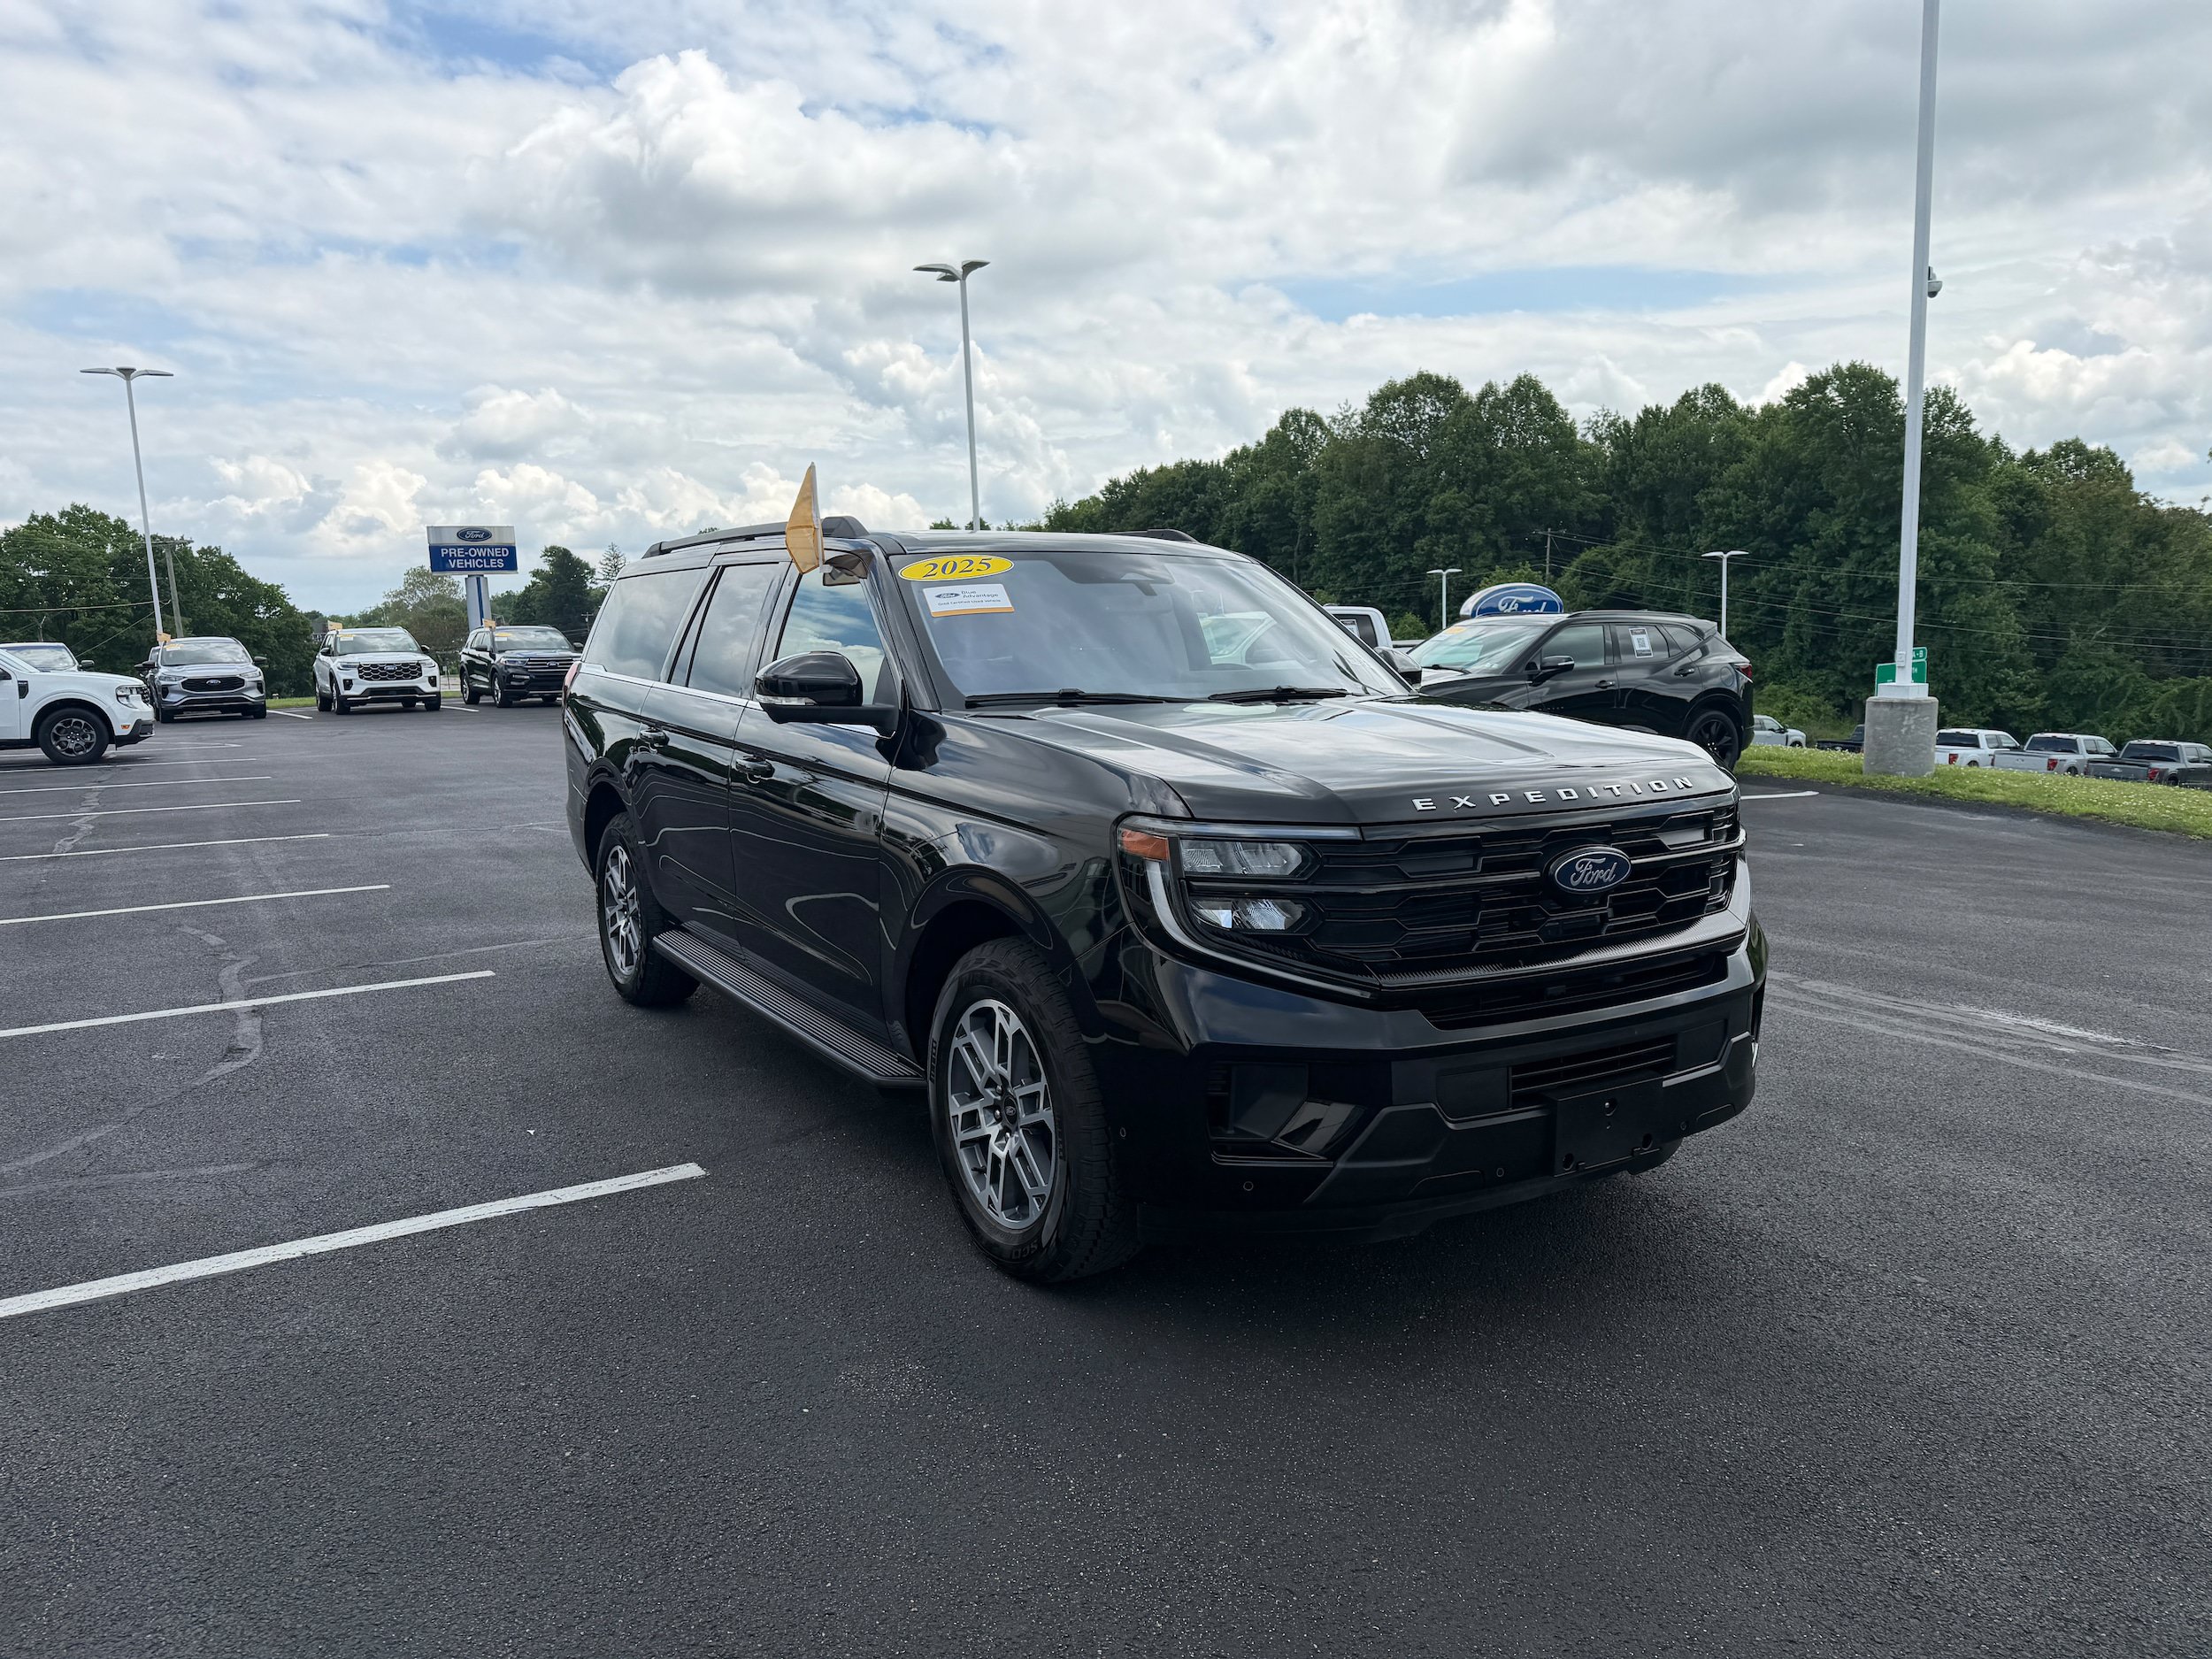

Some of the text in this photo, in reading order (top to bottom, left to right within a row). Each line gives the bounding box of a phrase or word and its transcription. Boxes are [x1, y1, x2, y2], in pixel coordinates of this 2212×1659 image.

[465, 530, 485, 539] Ford
[441, 547, 510, 557] PRE-OWNED
[449, 558, 504, 569] VEHICLES
[922, 557, 993, 578] 2025
[1498, 595, 1548, 613] Fd
[1411, 777, 1694, 811] EXPEDITION
[1570, 857, 1618, 886] Ford
